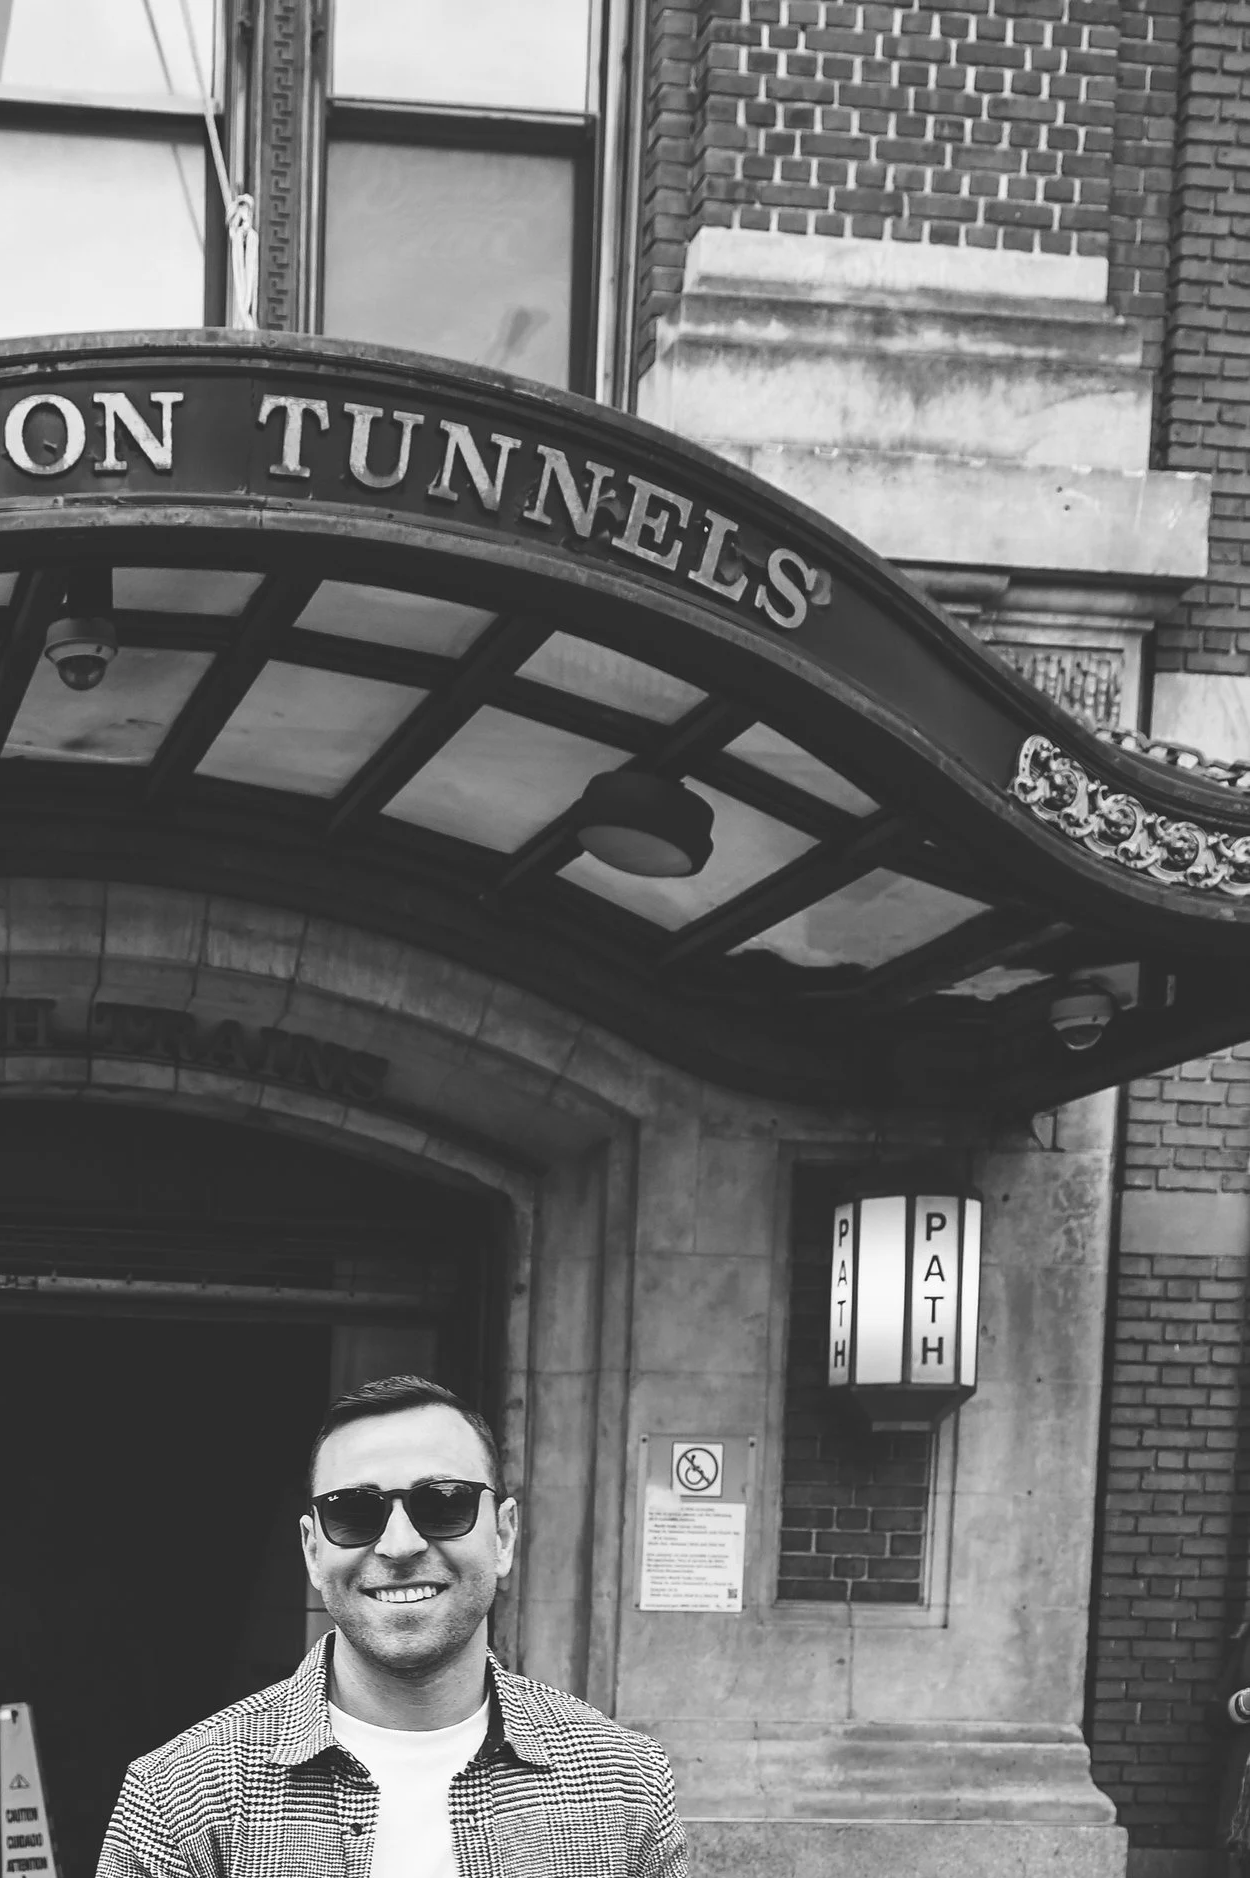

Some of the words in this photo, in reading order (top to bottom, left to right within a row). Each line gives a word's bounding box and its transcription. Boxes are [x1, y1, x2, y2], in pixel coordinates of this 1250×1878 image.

[256, 394, 821, 630] TUNNELS
[834, 1218, 849, 1369] PATH
[921, 1212, 947, 1365] PATH
[6, 1807, 39, 1823] CAUTION
[7, 1832, 44, 1849] CUIDADO
[7, 1857, 48, 1872] ATTENTION
